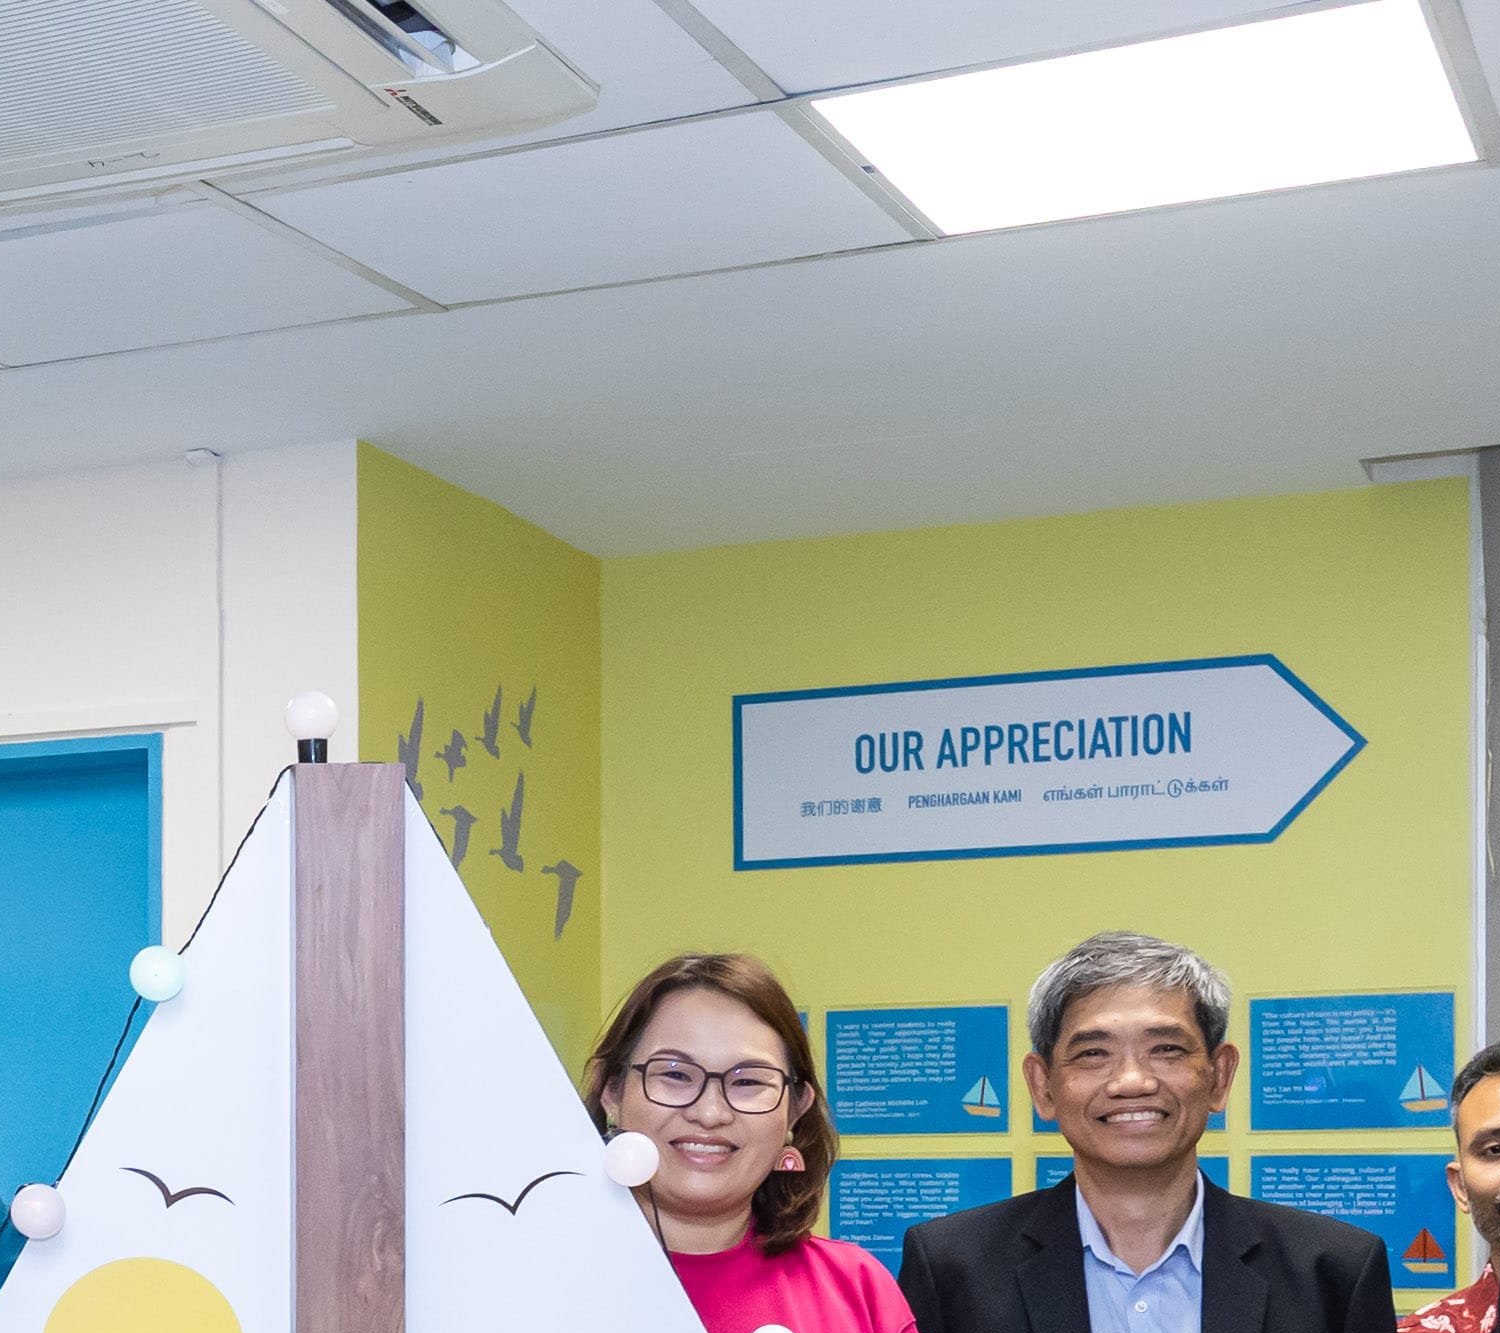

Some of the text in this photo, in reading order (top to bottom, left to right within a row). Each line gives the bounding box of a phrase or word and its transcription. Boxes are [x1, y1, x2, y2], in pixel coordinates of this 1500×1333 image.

[855, 711, 1192, 775] OUR APPRECIATION
[908, 788, 1022, 809] PENGHARGAAN KAMI
